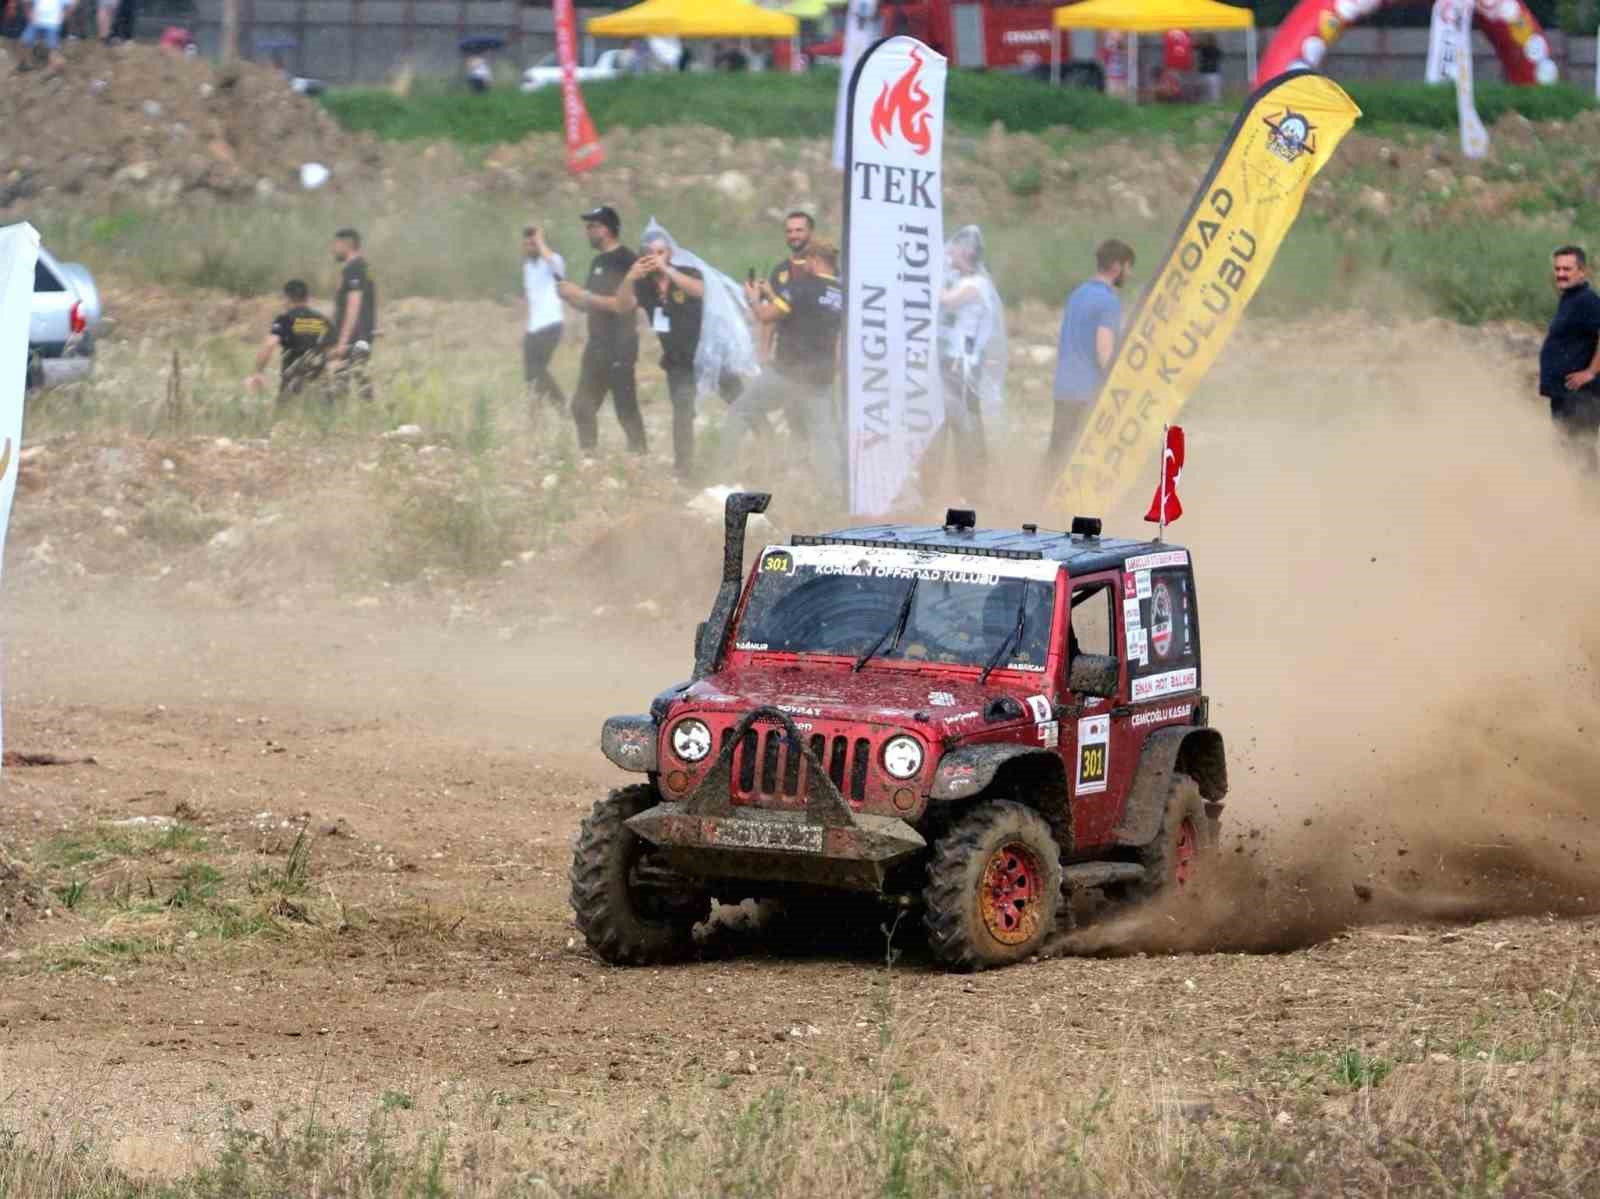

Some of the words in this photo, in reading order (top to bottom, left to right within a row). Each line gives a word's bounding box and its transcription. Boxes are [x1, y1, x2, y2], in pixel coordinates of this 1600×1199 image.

[855, 162, 937, 209] TEK
[896, 223, 934, 447] ÜVENLİĞİ
[1127, 186, 1234, 371] OFFROAD
[1157, 228, 1257, 384] KULÜBÜ
[861, 283, 891, 449] YANGIN
[765, 557, 788, 572] 301
[1083, 749, 1103, 779] 301
